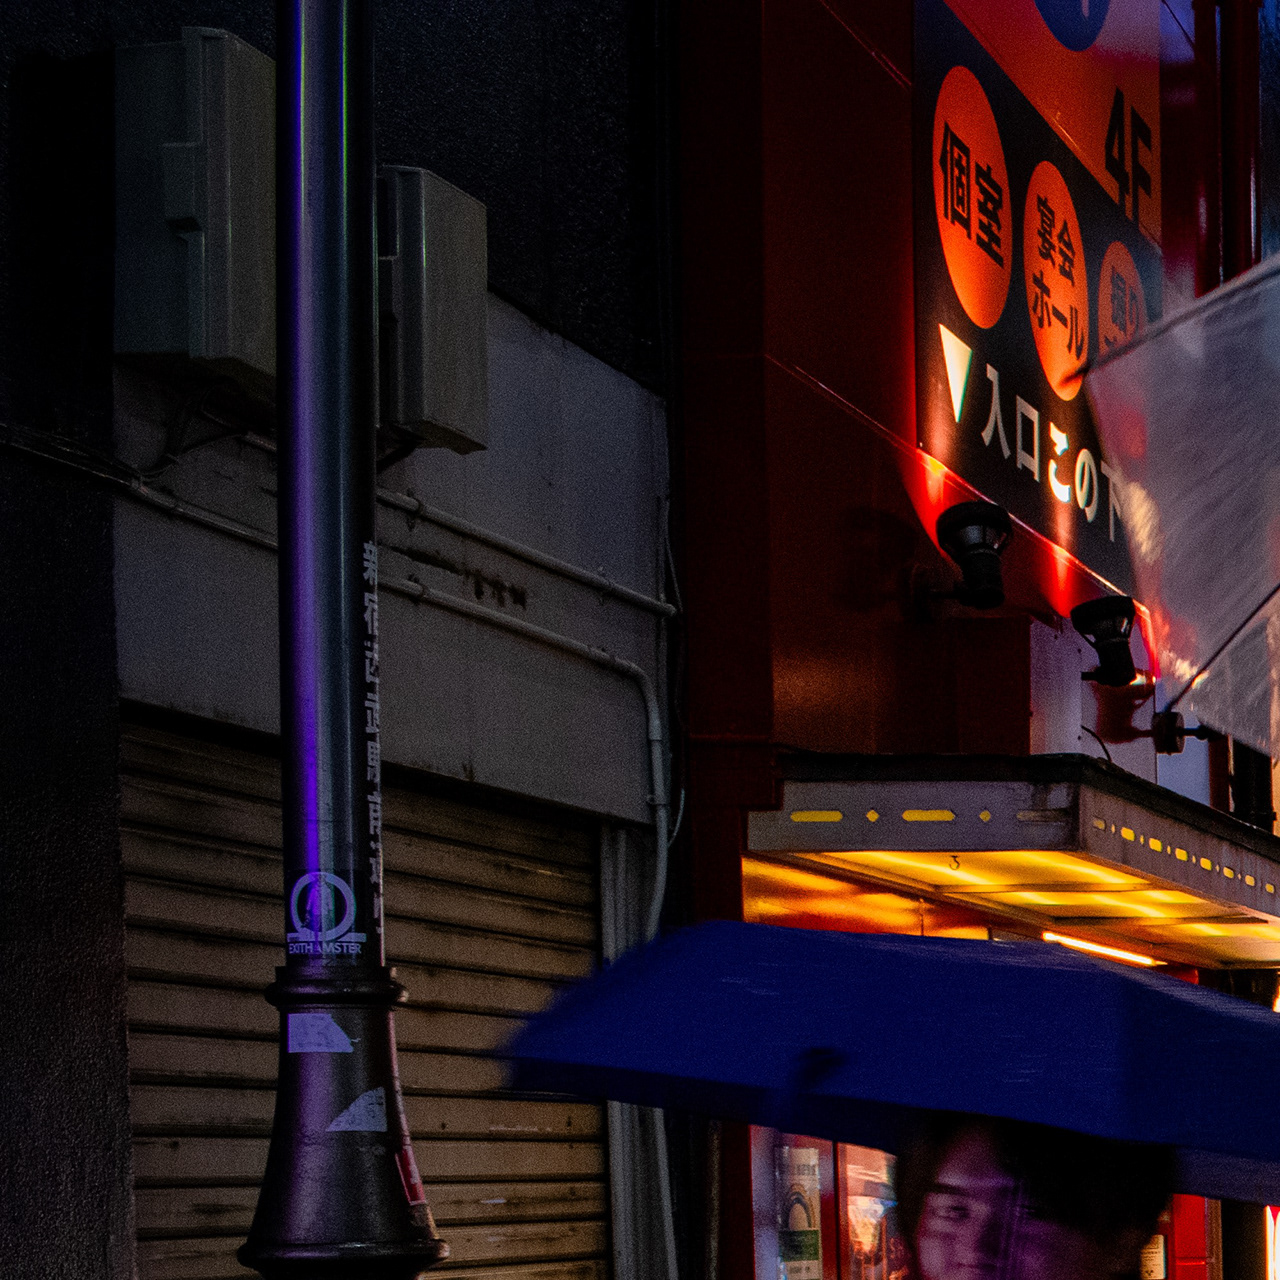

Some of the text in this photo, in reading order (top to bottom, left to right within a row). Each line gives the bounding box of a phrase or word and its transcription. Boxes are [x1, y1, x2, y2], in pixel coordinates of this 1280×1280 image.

[938, 120, 1004, 270] 個室
[1105, 86, 1152, 226] 4F
[1035, 192, 1076, 288] 宴会
[1031, 270, 1086, 360] ホール
[980, 362, 1123, 543] 入口この下
